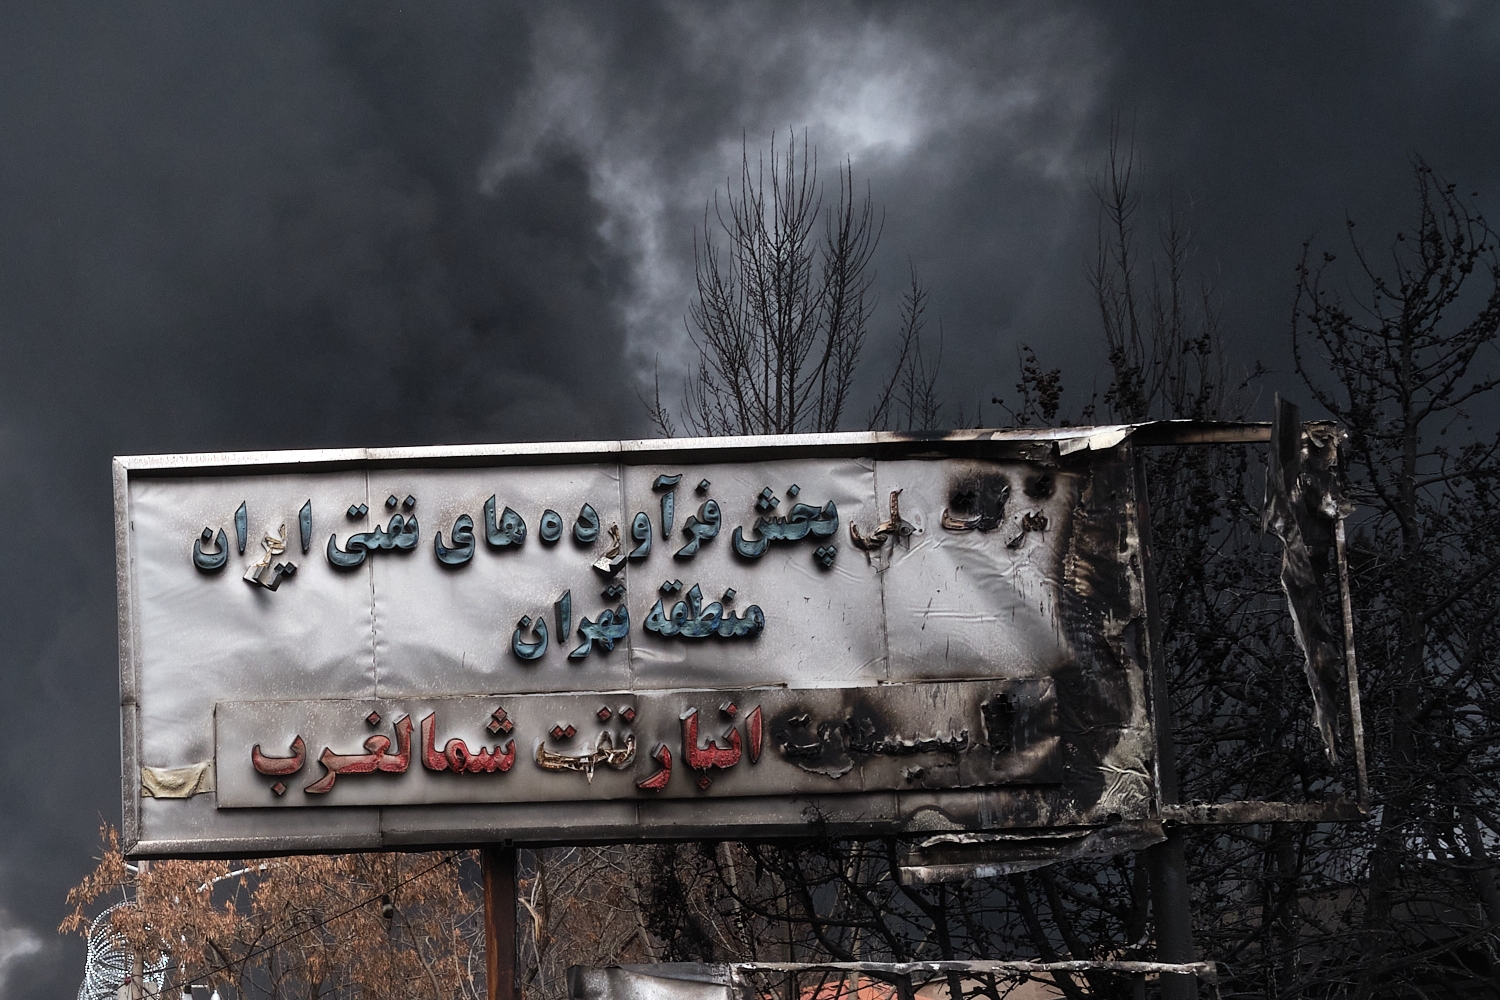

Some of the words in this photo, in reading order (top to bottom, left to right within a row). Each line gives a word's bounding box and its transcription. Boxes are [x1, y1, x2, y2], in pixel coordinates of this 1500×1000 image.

[192, 499, 313, 592] ایران
[326, 493, 420, 569] نفتی
[732, 483, 840, 568] پخش
[511, 583, 631, 660] تهران
[642, 579, 766, 638] منطقه
[534, 705, 637, 786] نفت
[637, 700, 763, 791] انبار
